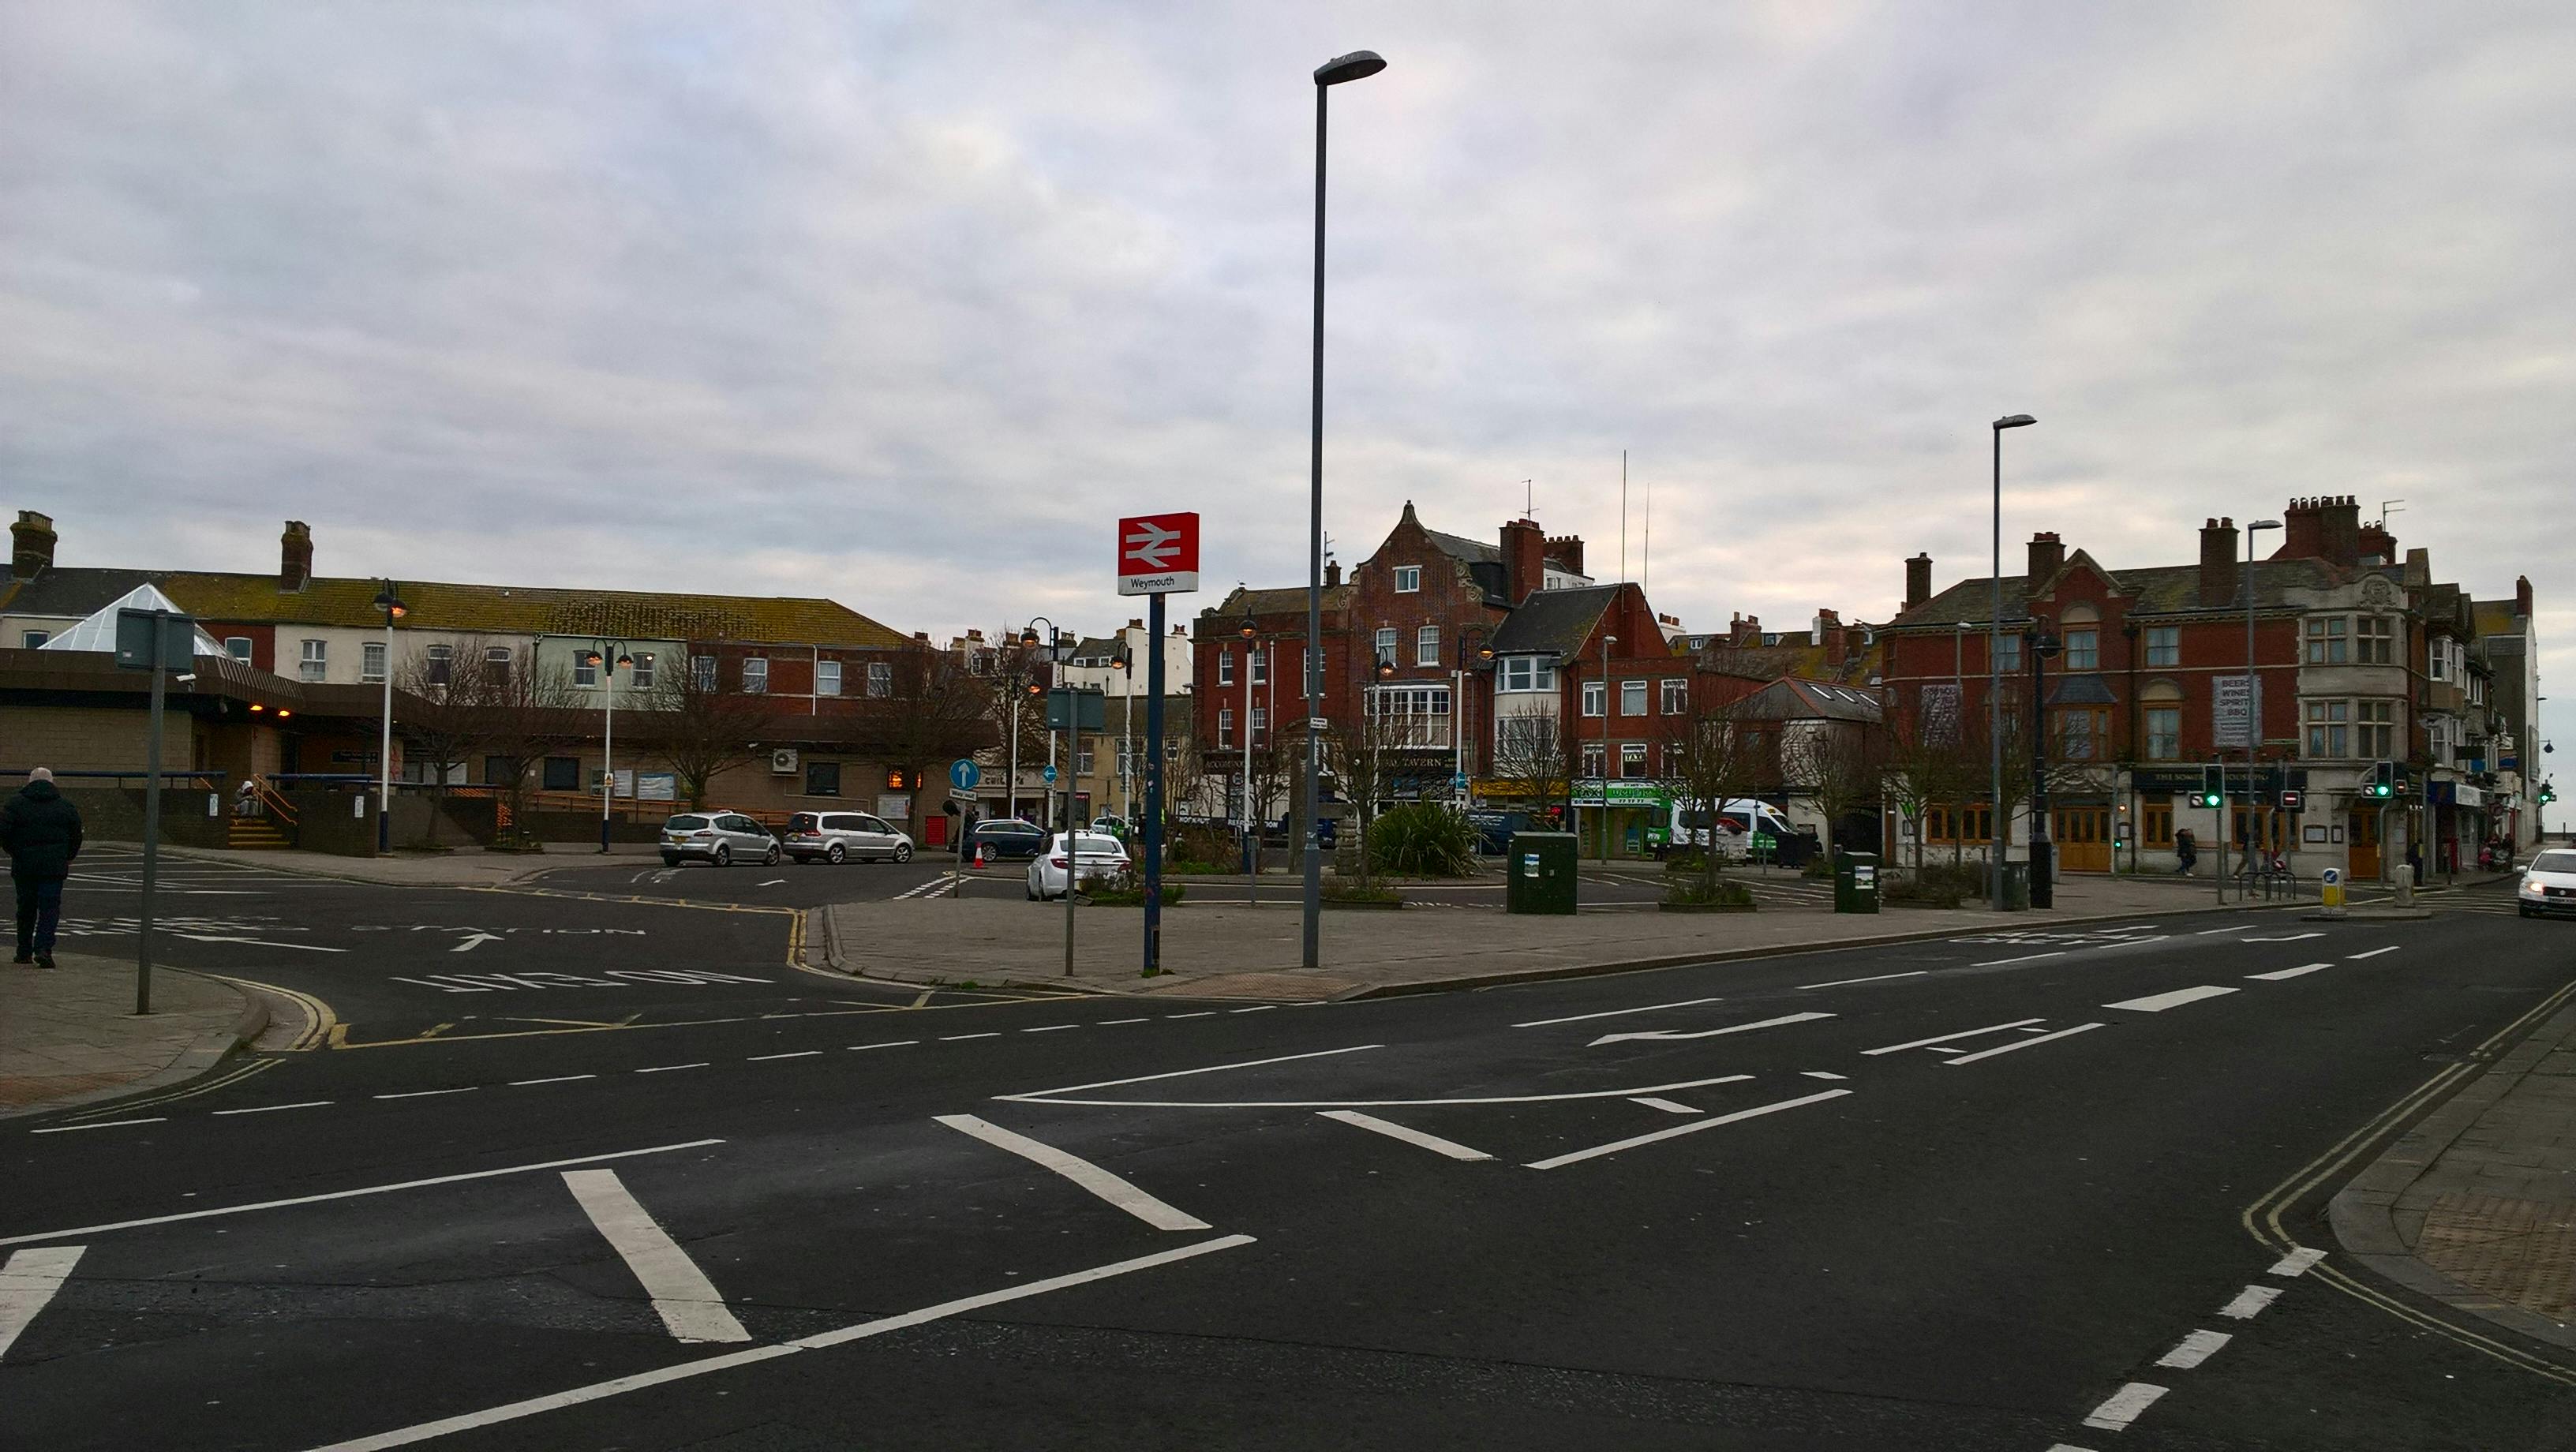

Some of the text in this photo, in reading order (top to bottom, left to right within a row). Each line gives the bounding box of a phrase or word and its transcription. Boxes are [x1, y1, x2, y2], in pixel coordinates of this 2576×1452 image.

[1131, 576, 1174, 590] Weymouth
[1403, 758, 1442, 767] TAVERN
[351, 925, 646, 935] STATION
